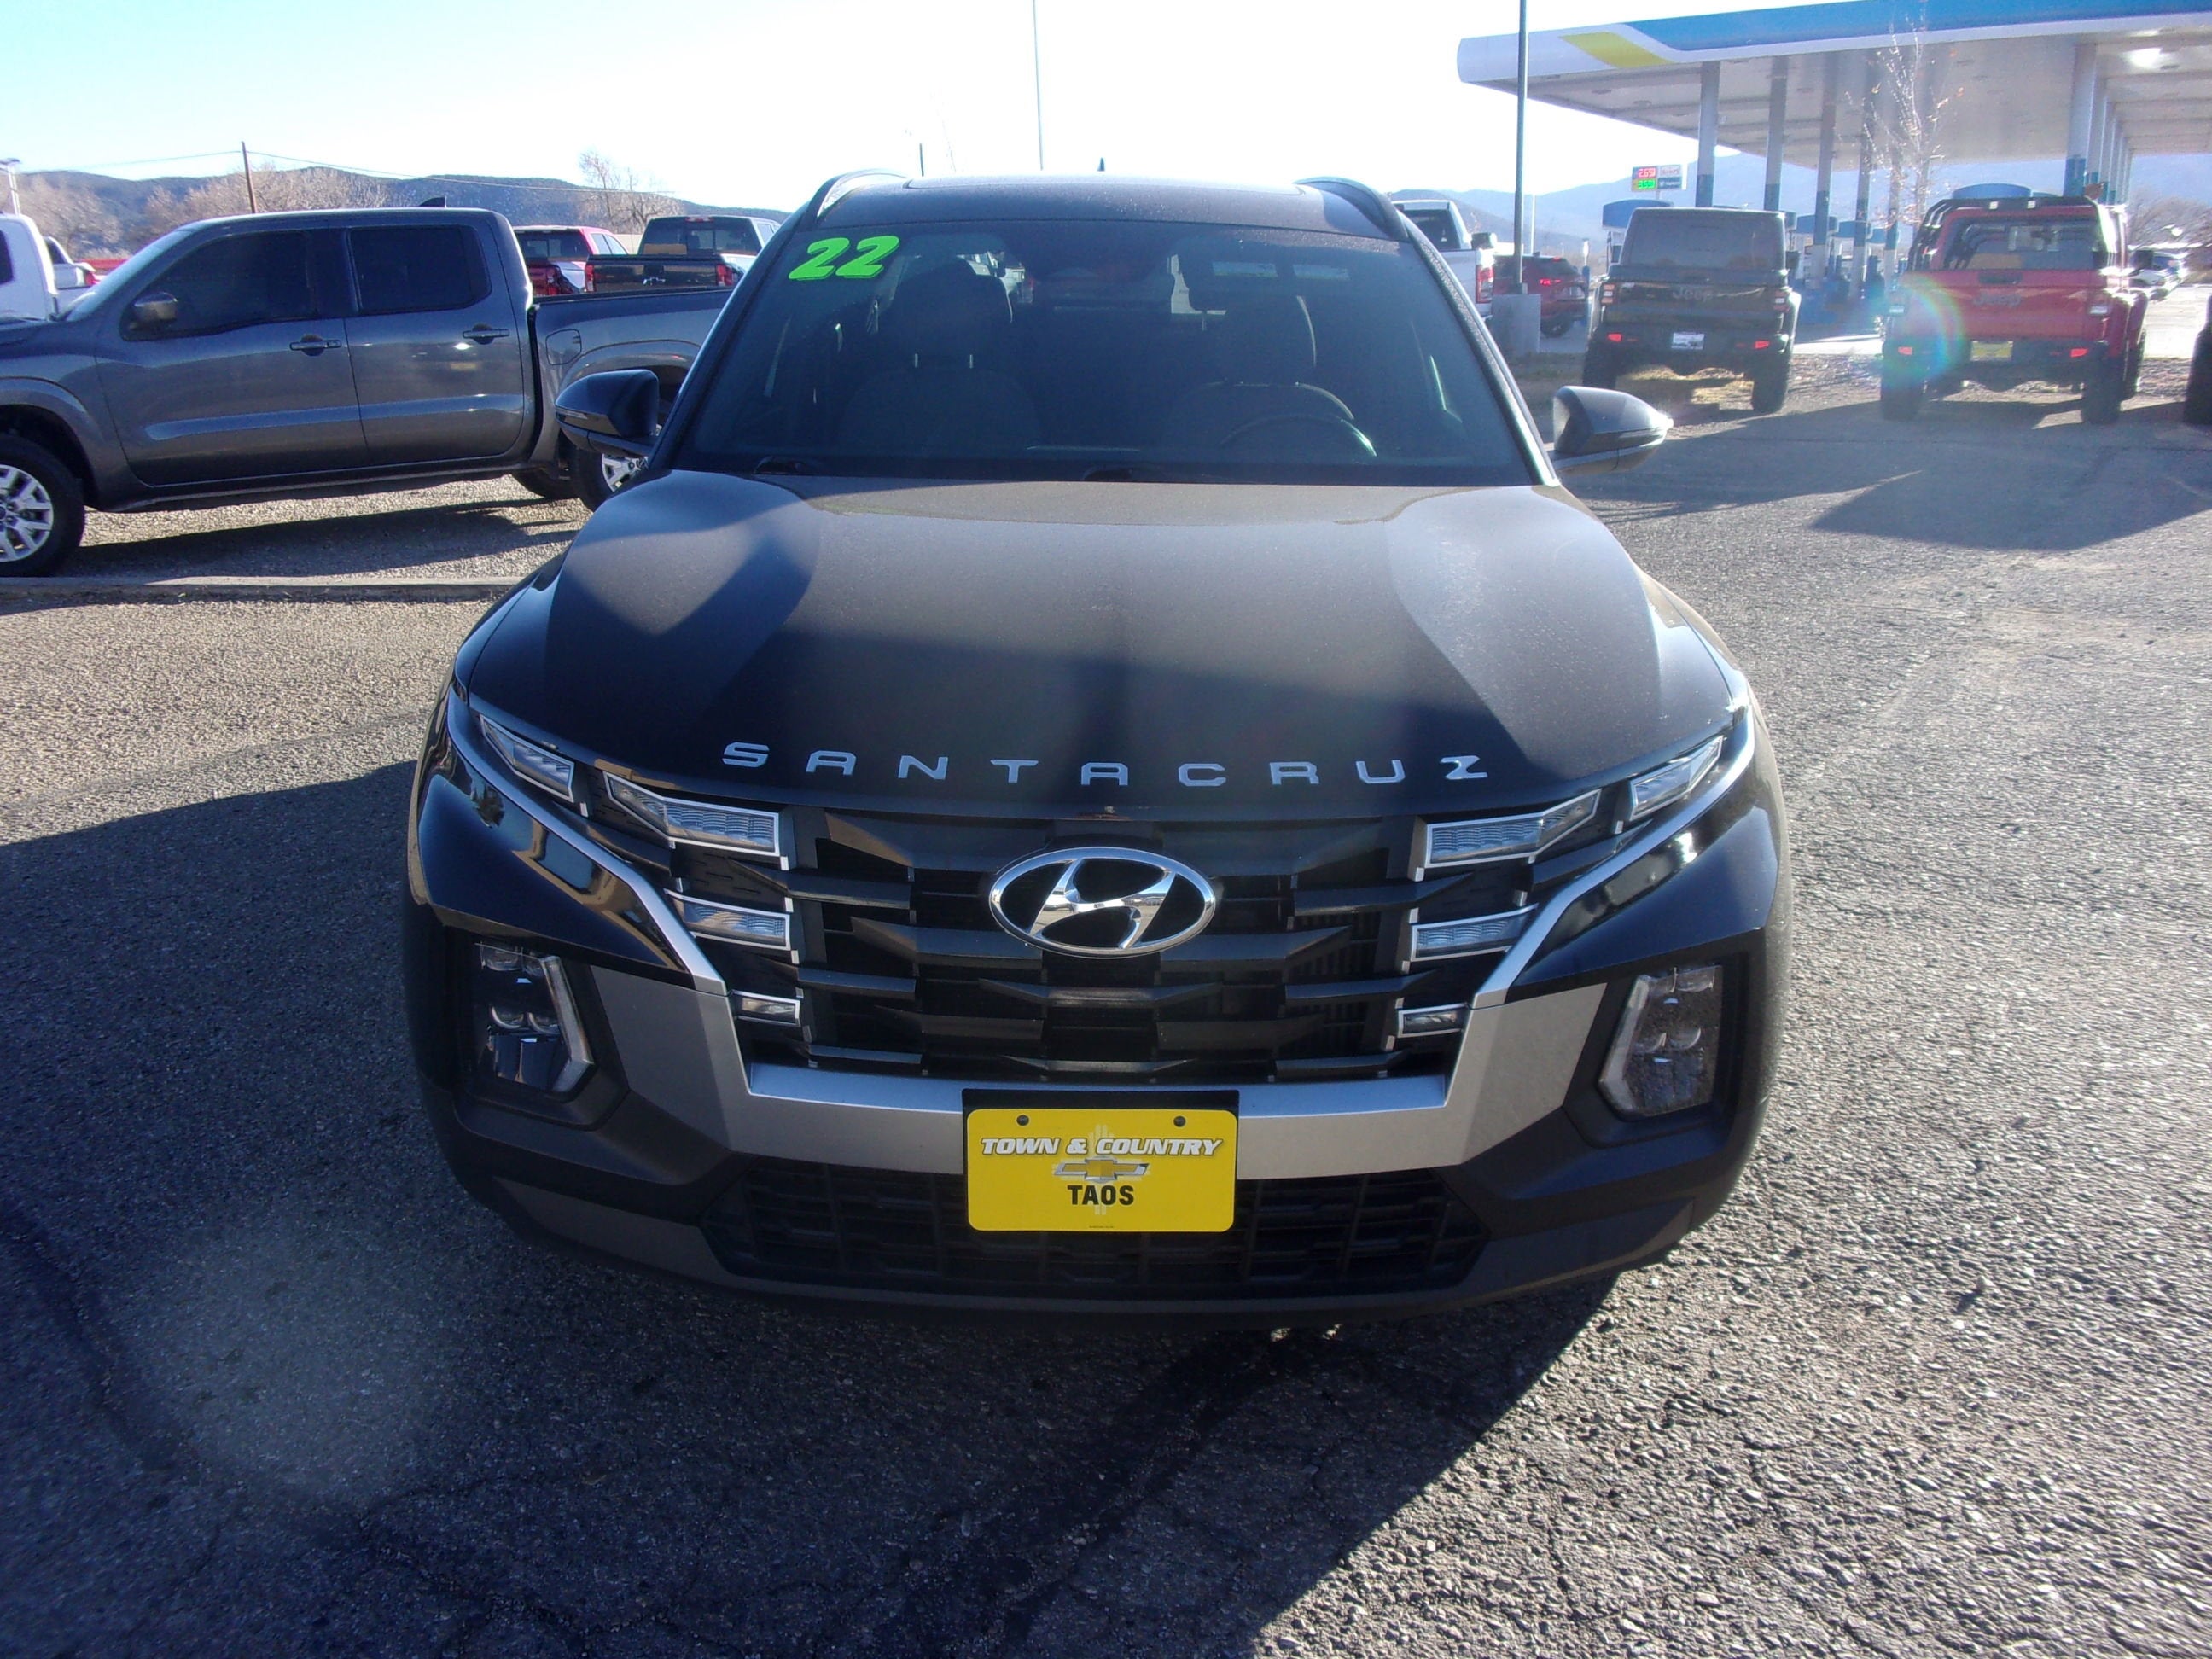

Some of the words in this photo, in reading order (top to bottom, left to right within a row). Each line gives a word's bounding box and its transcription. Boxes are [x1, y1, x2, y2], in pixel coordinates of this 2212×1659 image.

[789, 236, 900, 281] 22
[981, 1138, 1060, 1155] TOWN
[1065, 1138, 1088, 1155] &
[1096, 1138, 1224, 1156] COUNTRY
[1067, 1185, 1135, 1205] TAOS
